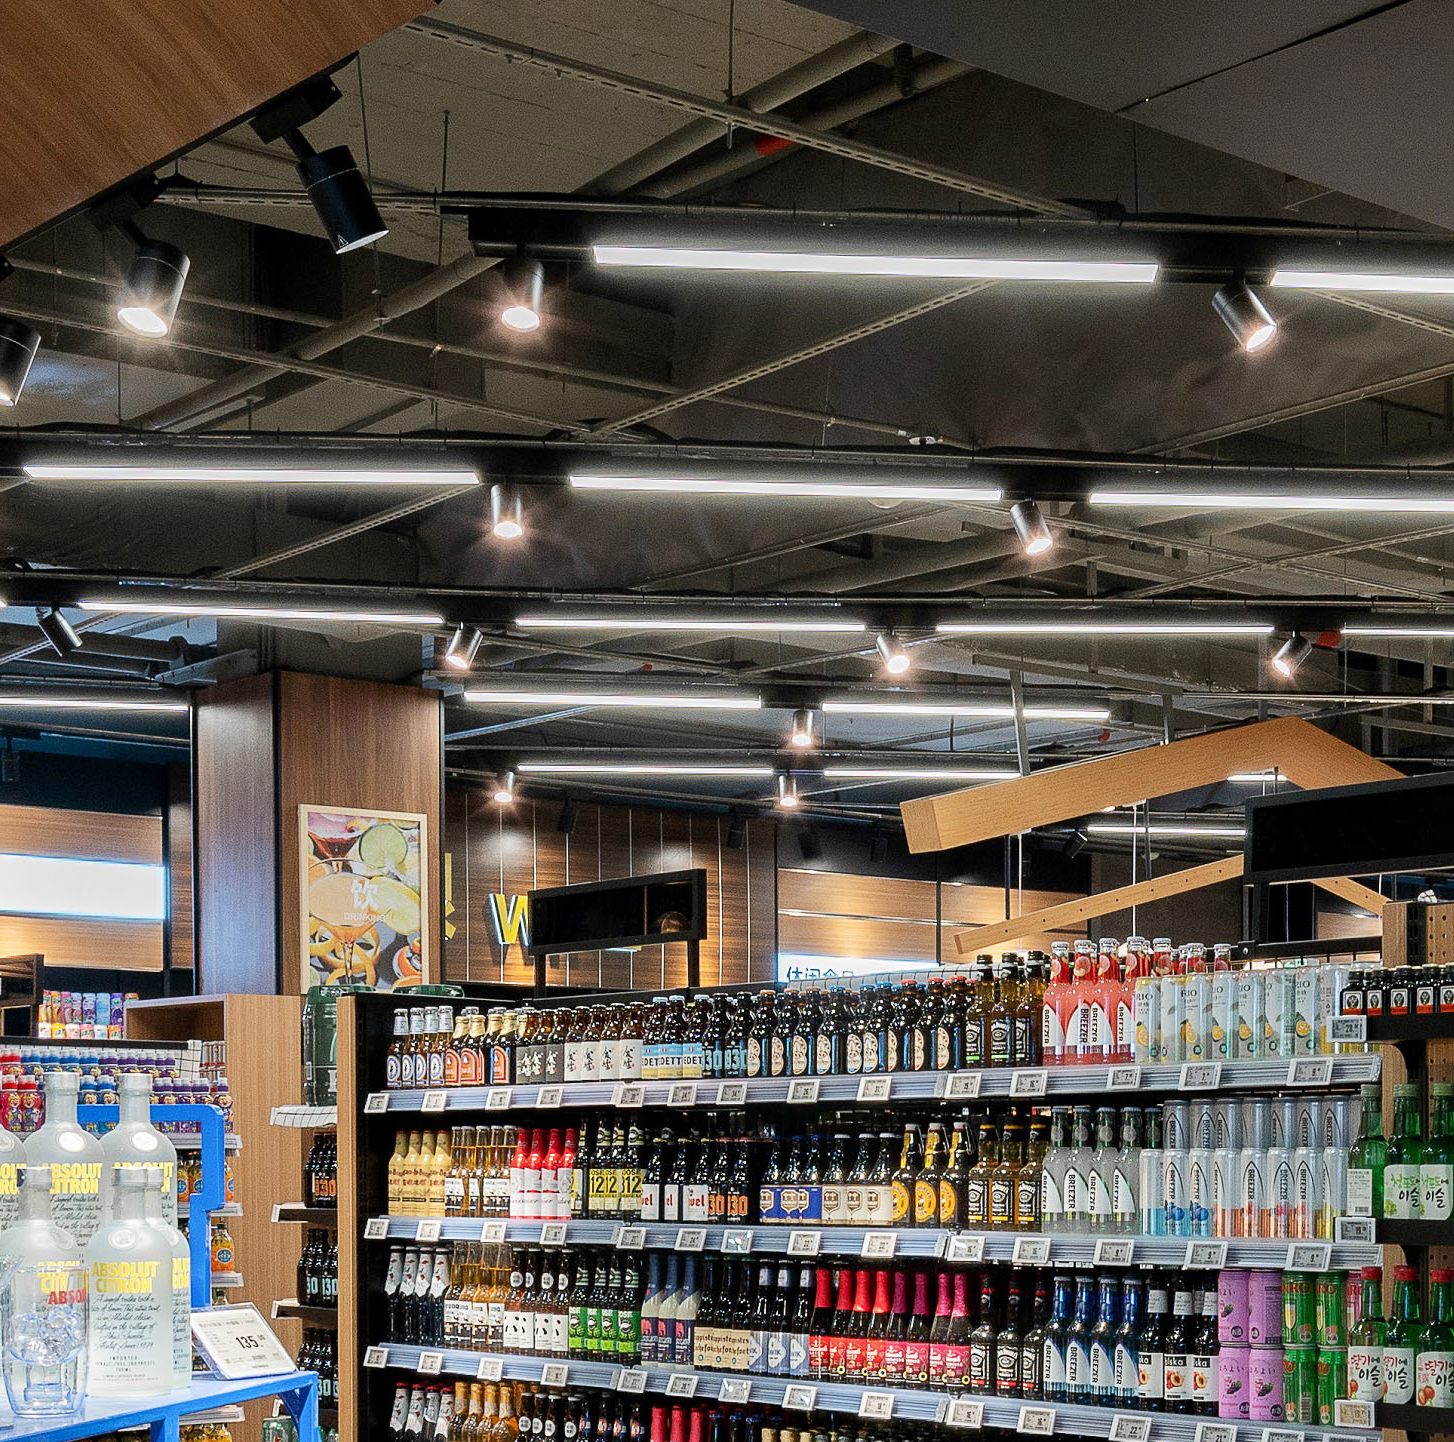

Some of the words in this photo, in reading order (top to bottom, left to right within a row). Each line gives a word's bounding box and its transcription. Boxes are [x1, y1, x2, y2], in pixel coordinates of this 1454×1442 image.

[343, 912, 388, 922] DRINKING
[1180, 989, 1198, 999] RIO
[1080, 1008, 1088, 1045] BREEZER
[1068, 1174, 1076, 1210] BREEZER
[1425, 1187, 1446, 1209] 이슬
[92, 1261, 161, 1278] ABSOLUT
[96, 1277, 153, 1294] CITRON
[1069, 1346, 1077, 1382] BREEZER
[1091, 1348, 1099, 1383] BREEZER
[1358, 1364, 1381, 1388] 이슬
[1388, 1365, 1409, 1389] 이슬
